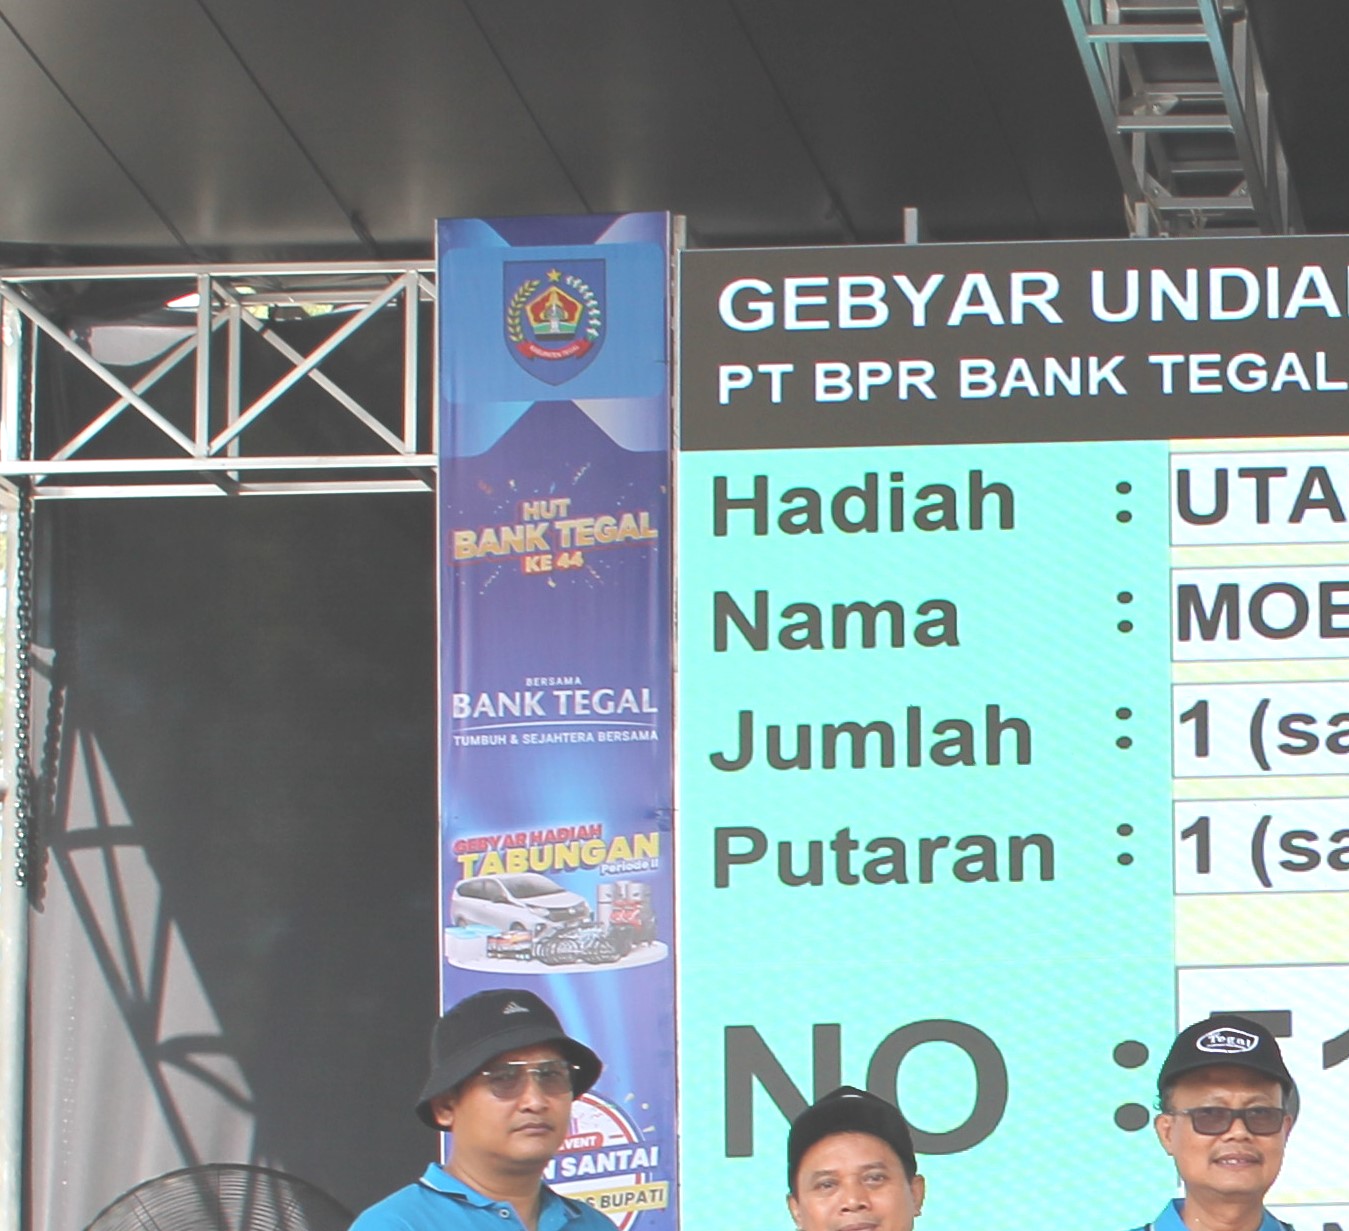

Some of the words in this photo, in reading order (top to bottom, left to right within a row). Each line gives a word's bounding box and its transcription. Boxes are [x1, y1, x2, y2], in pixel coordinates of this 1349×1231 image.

[717, 270, 1063, 332] GEBYAR
[718, 362, 794, 405] PT
[814, 359, 938, 403] BPR
[959, 355, 1128, 399] BANK
[1149, 351, 1349, 394] TEGAL
[522, 498, 571, 521] HUT
[712, 469, 1016, 537] Hadiah
[453, 522, 551, 560] BANK
[553, 512, 659, 548] TEGAL
[525, 555, 553, 573] KE
[556, 551, 584, 569] 44
[712, 589, 961, 653] Nama
[452, 690, 546, 719] BANK
[553, 688, 659, 716] TEGAL
[525, 677, 582, 687] BERSAMA
[453, 734, 507, 746] TUMBUH
[510, 734, 519, 745] &
[522, 732, 594, 744] SEJAHTERA
[598, 731, 659, 743] BERSAMA
[708, 704, 1033, 772] Jumlah
[1178, 700, 1211, 757] 1
[453, 831, 526, 853] GEBYAR
[529, 824, 603, 846] HADIAH
[457, 832, 660, 880] TABUNGAN
[712, 825, 1056, 889] Putaran
[1178, 816, 1212, 875] 1
[723, 1018, 1010, 1158] NO
[560, 1147, 659, 1178] SANTAI
[600, 1189, 665, 1209] BUPATI
